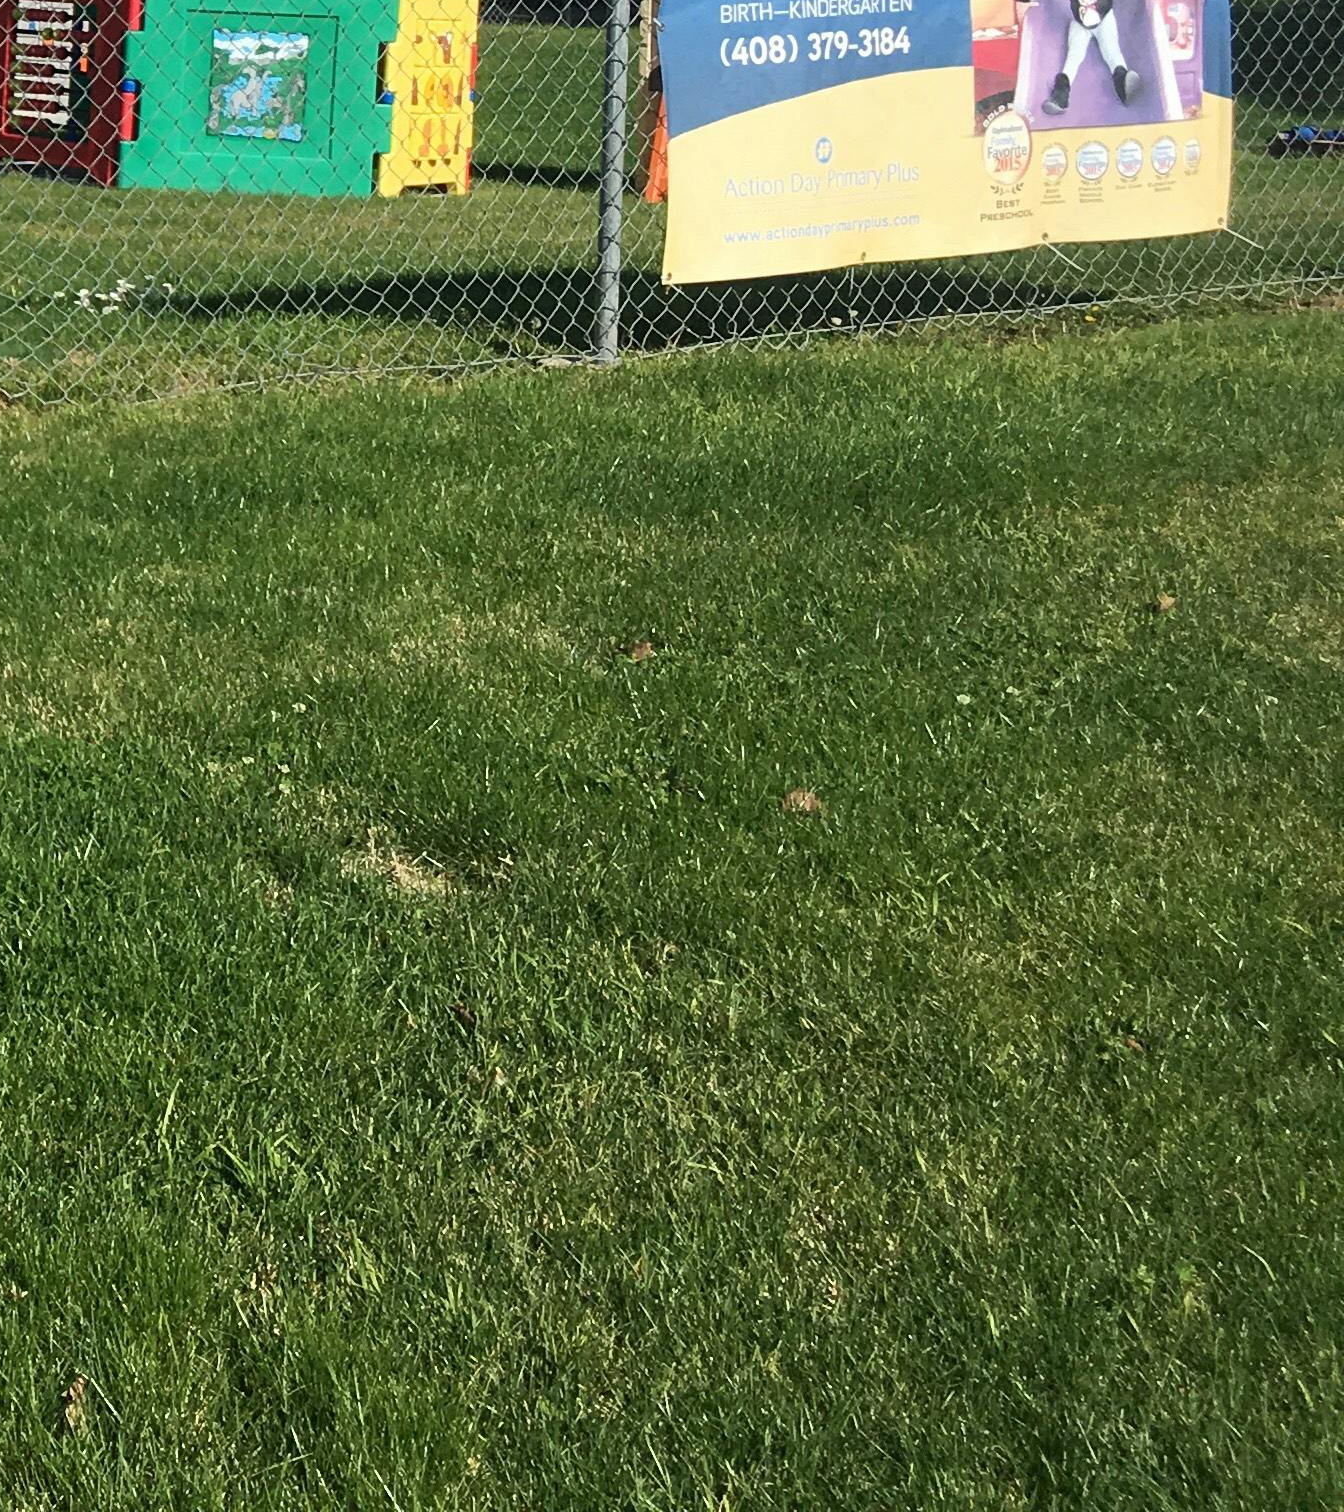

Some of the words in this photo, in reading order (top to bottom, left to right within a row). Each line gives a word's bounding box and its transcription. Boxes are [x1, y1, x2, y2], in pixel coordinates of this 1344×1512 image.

[720, 34, 799, 67] (408)
[807, 25, 911, 62] 379-3184
[987, 146, 1028, 159] Favorite
[994, 157, 1022, 173] 2015
[724, 176, 785, 199] Action
[789, 173, 821, 195] Day
[827, 168, 883, 190] Primary
[886, 162, 920, 183] Plus
[980, 209, 1034, 223] PRESCHOOL
[723, 213, 921, 244] www.actiondayprimaryplus.com
